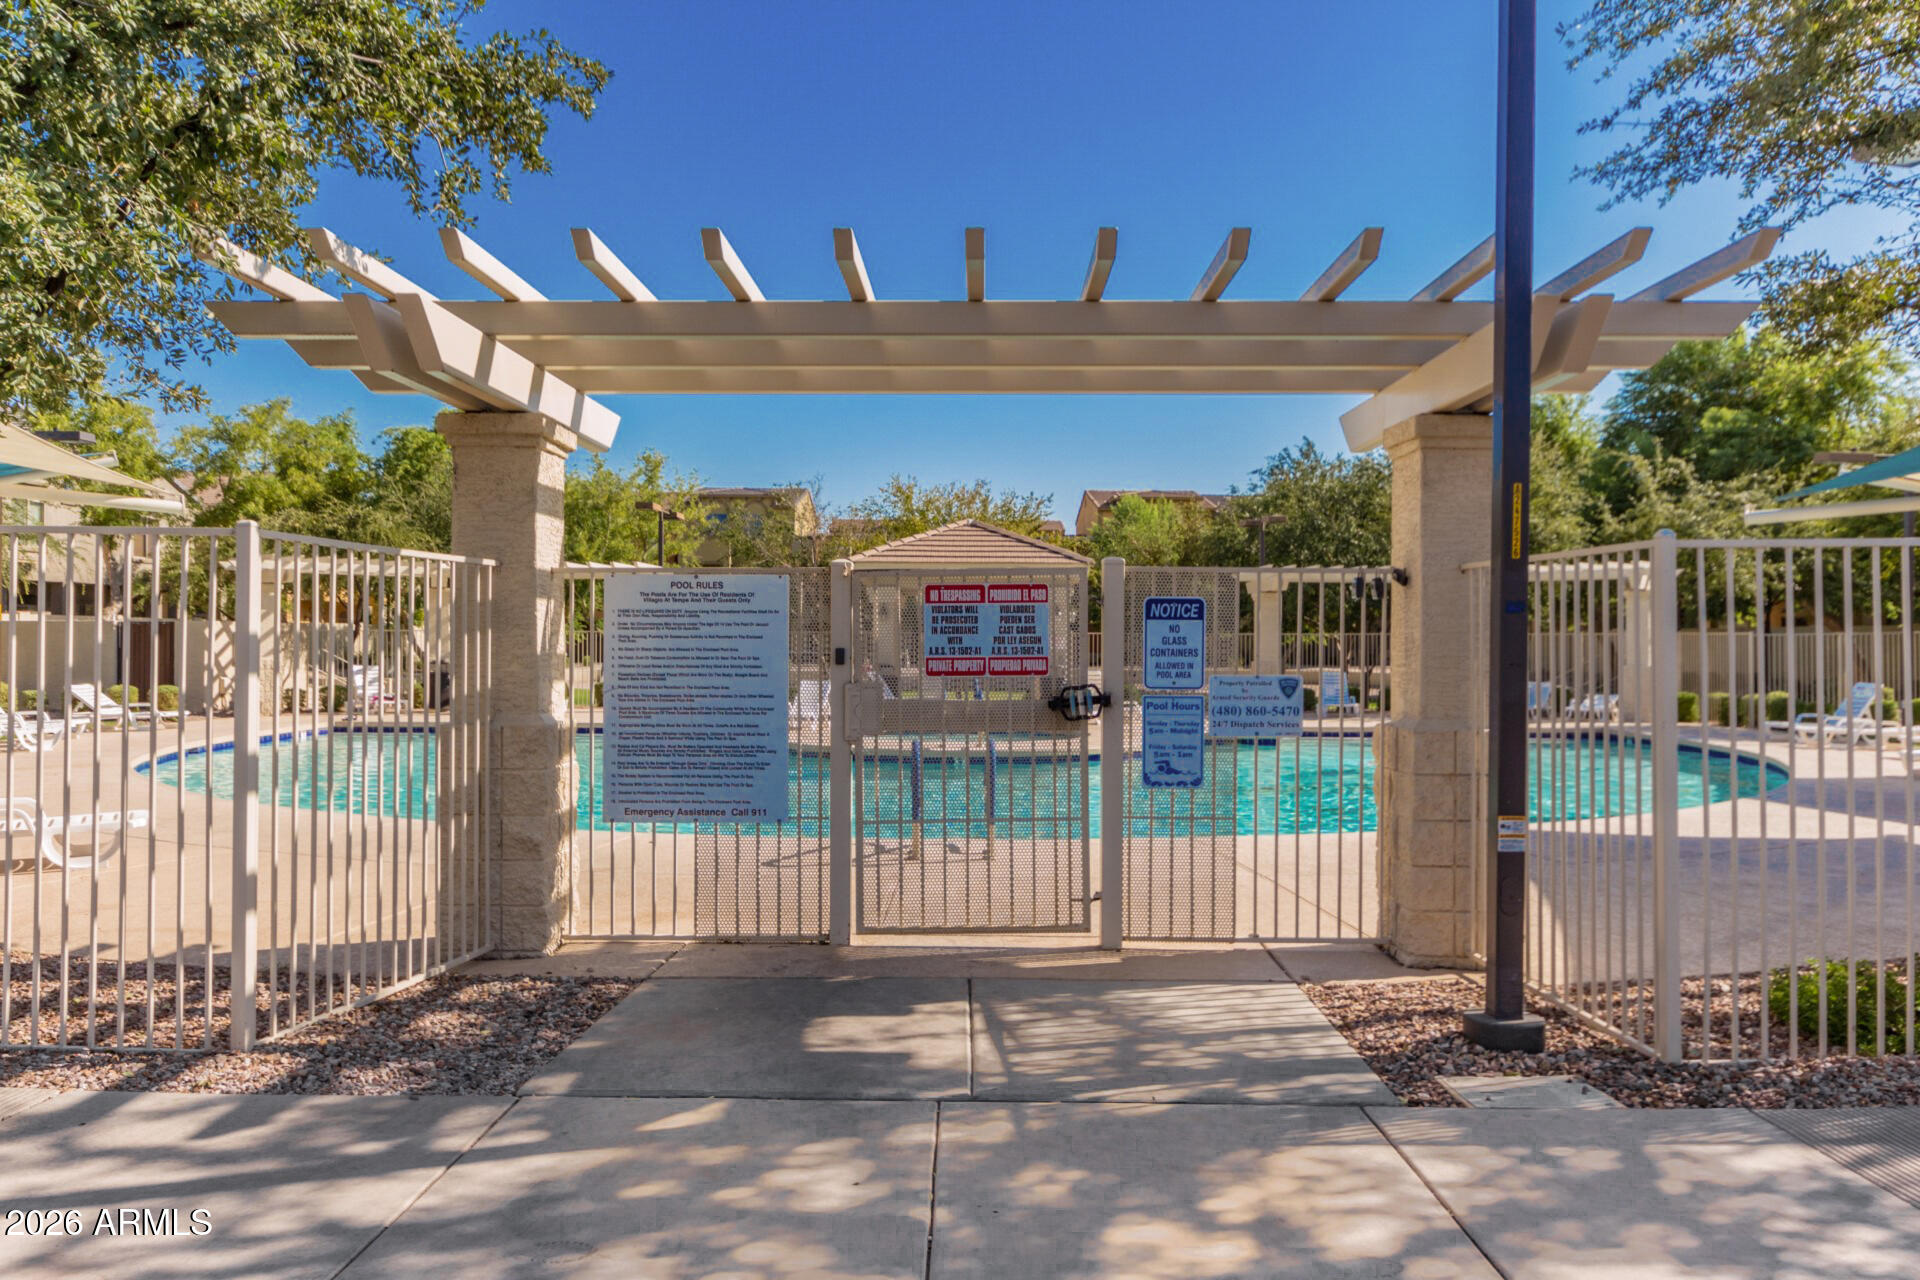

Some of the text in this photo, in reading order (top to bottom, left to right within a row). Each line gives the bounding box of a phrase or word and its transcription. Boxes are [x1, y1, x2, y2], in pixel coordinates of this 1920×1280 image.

[670, 581, 724, 589] POOL RULES
[930, 589, 981, 601] NO TRESPASSING
[989, 589, 1046, 601] PROHIBIDO EL PASO
[931, 605, 978, 613] VIOLATORS WILL
[1000, 605, 1035, 613] VIOLADORES
[1150, 603, 1200, 617] NOTICE
[931, 616, 978, 624] BE PROSECUTED
[1000, 615, 1035, 624] PUEDEN SER
[931, 626, 978, 634] IN ACCORDANCE
[1169, 624, 1180, 633] NO
[947, 636, 963, 644] WITH
[993, 636, 1042, 644] POR LEY ASEGUN
[1162, 636, 1187, 645] GLASS
[949, 647, 981, 655] 13-1502-A1
[1150, 648, 1199, 657] CONTAINERS
[928, 659, 984, 671] PRIVATE PROPERTY
[1022, 659, 1047, 671] PRIVADA
[1156, 671, 1191, 679] POOL AREA
[1147, 702, 1200, 710] Pool Hours
[1211, 706, 1300, 717] (480) 860-5470
[1212, 721, 1300, 729] 24/7 Dispatch Services
[624, 808, 767, 818] Emergency Assistance Call 911
